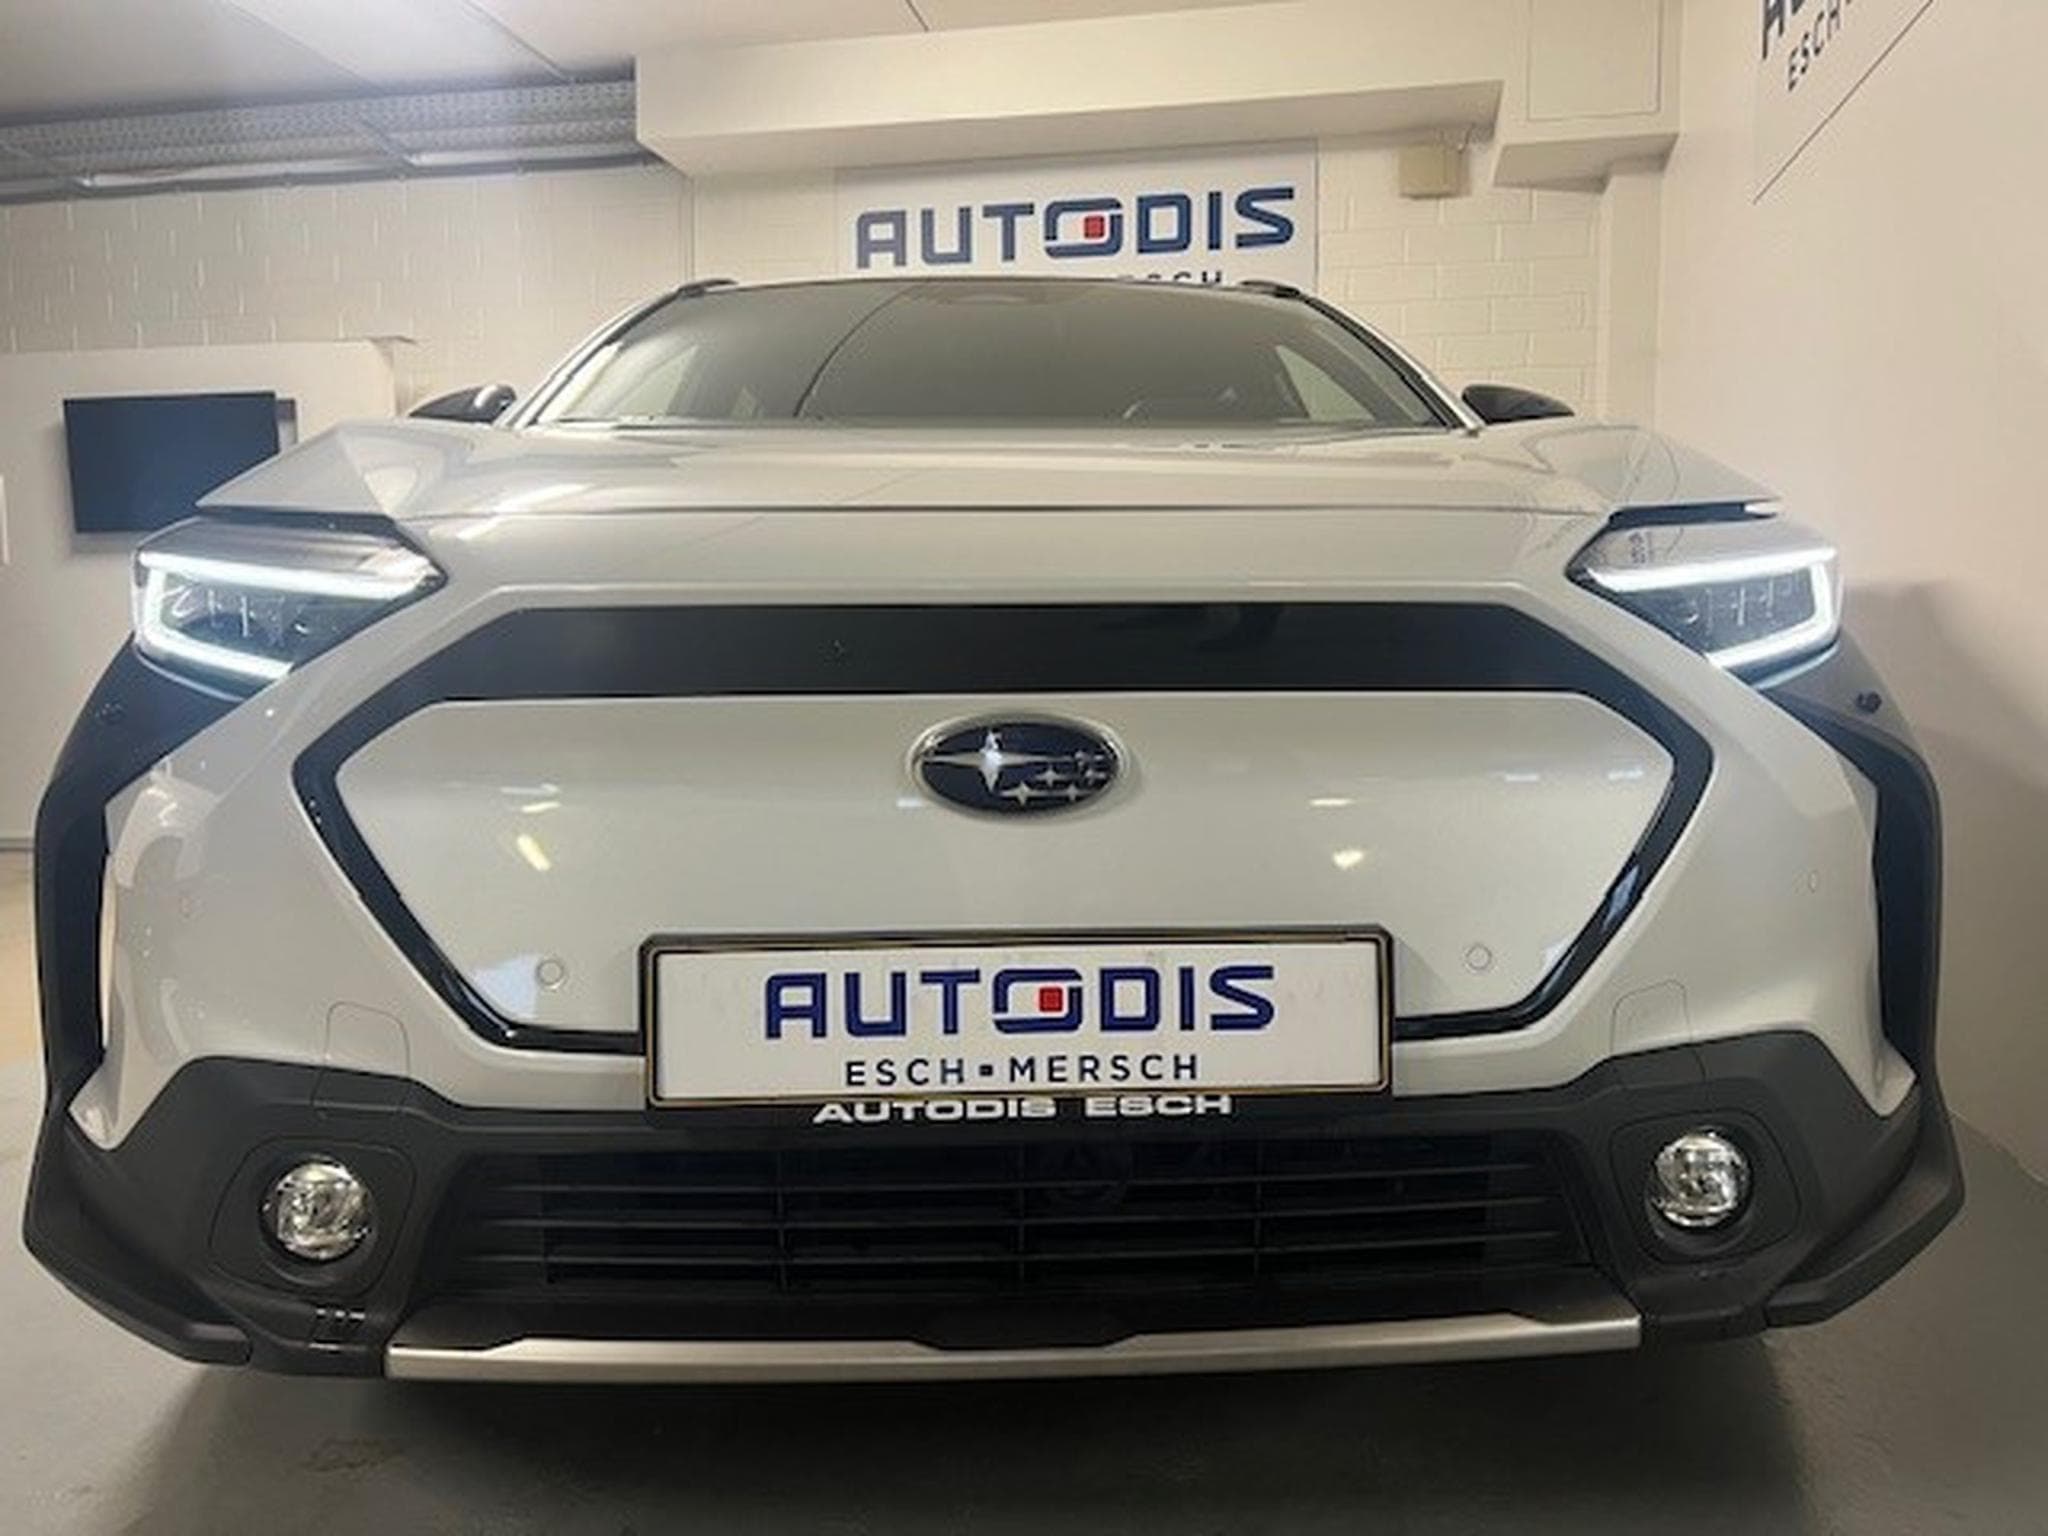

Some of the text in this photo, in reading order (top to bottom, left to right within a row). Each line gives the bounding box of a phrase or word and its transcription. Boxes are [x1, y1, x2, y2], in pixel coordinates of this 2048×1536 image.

[855, 187, 1296, 269] AUTODIS
[764, 965, 1275, 1040] AUTODIS
[845, 1053, 1198, 1087] ESCH MERSCH
[812, 1094, 1232, 1124] AUTODIS ESCH
